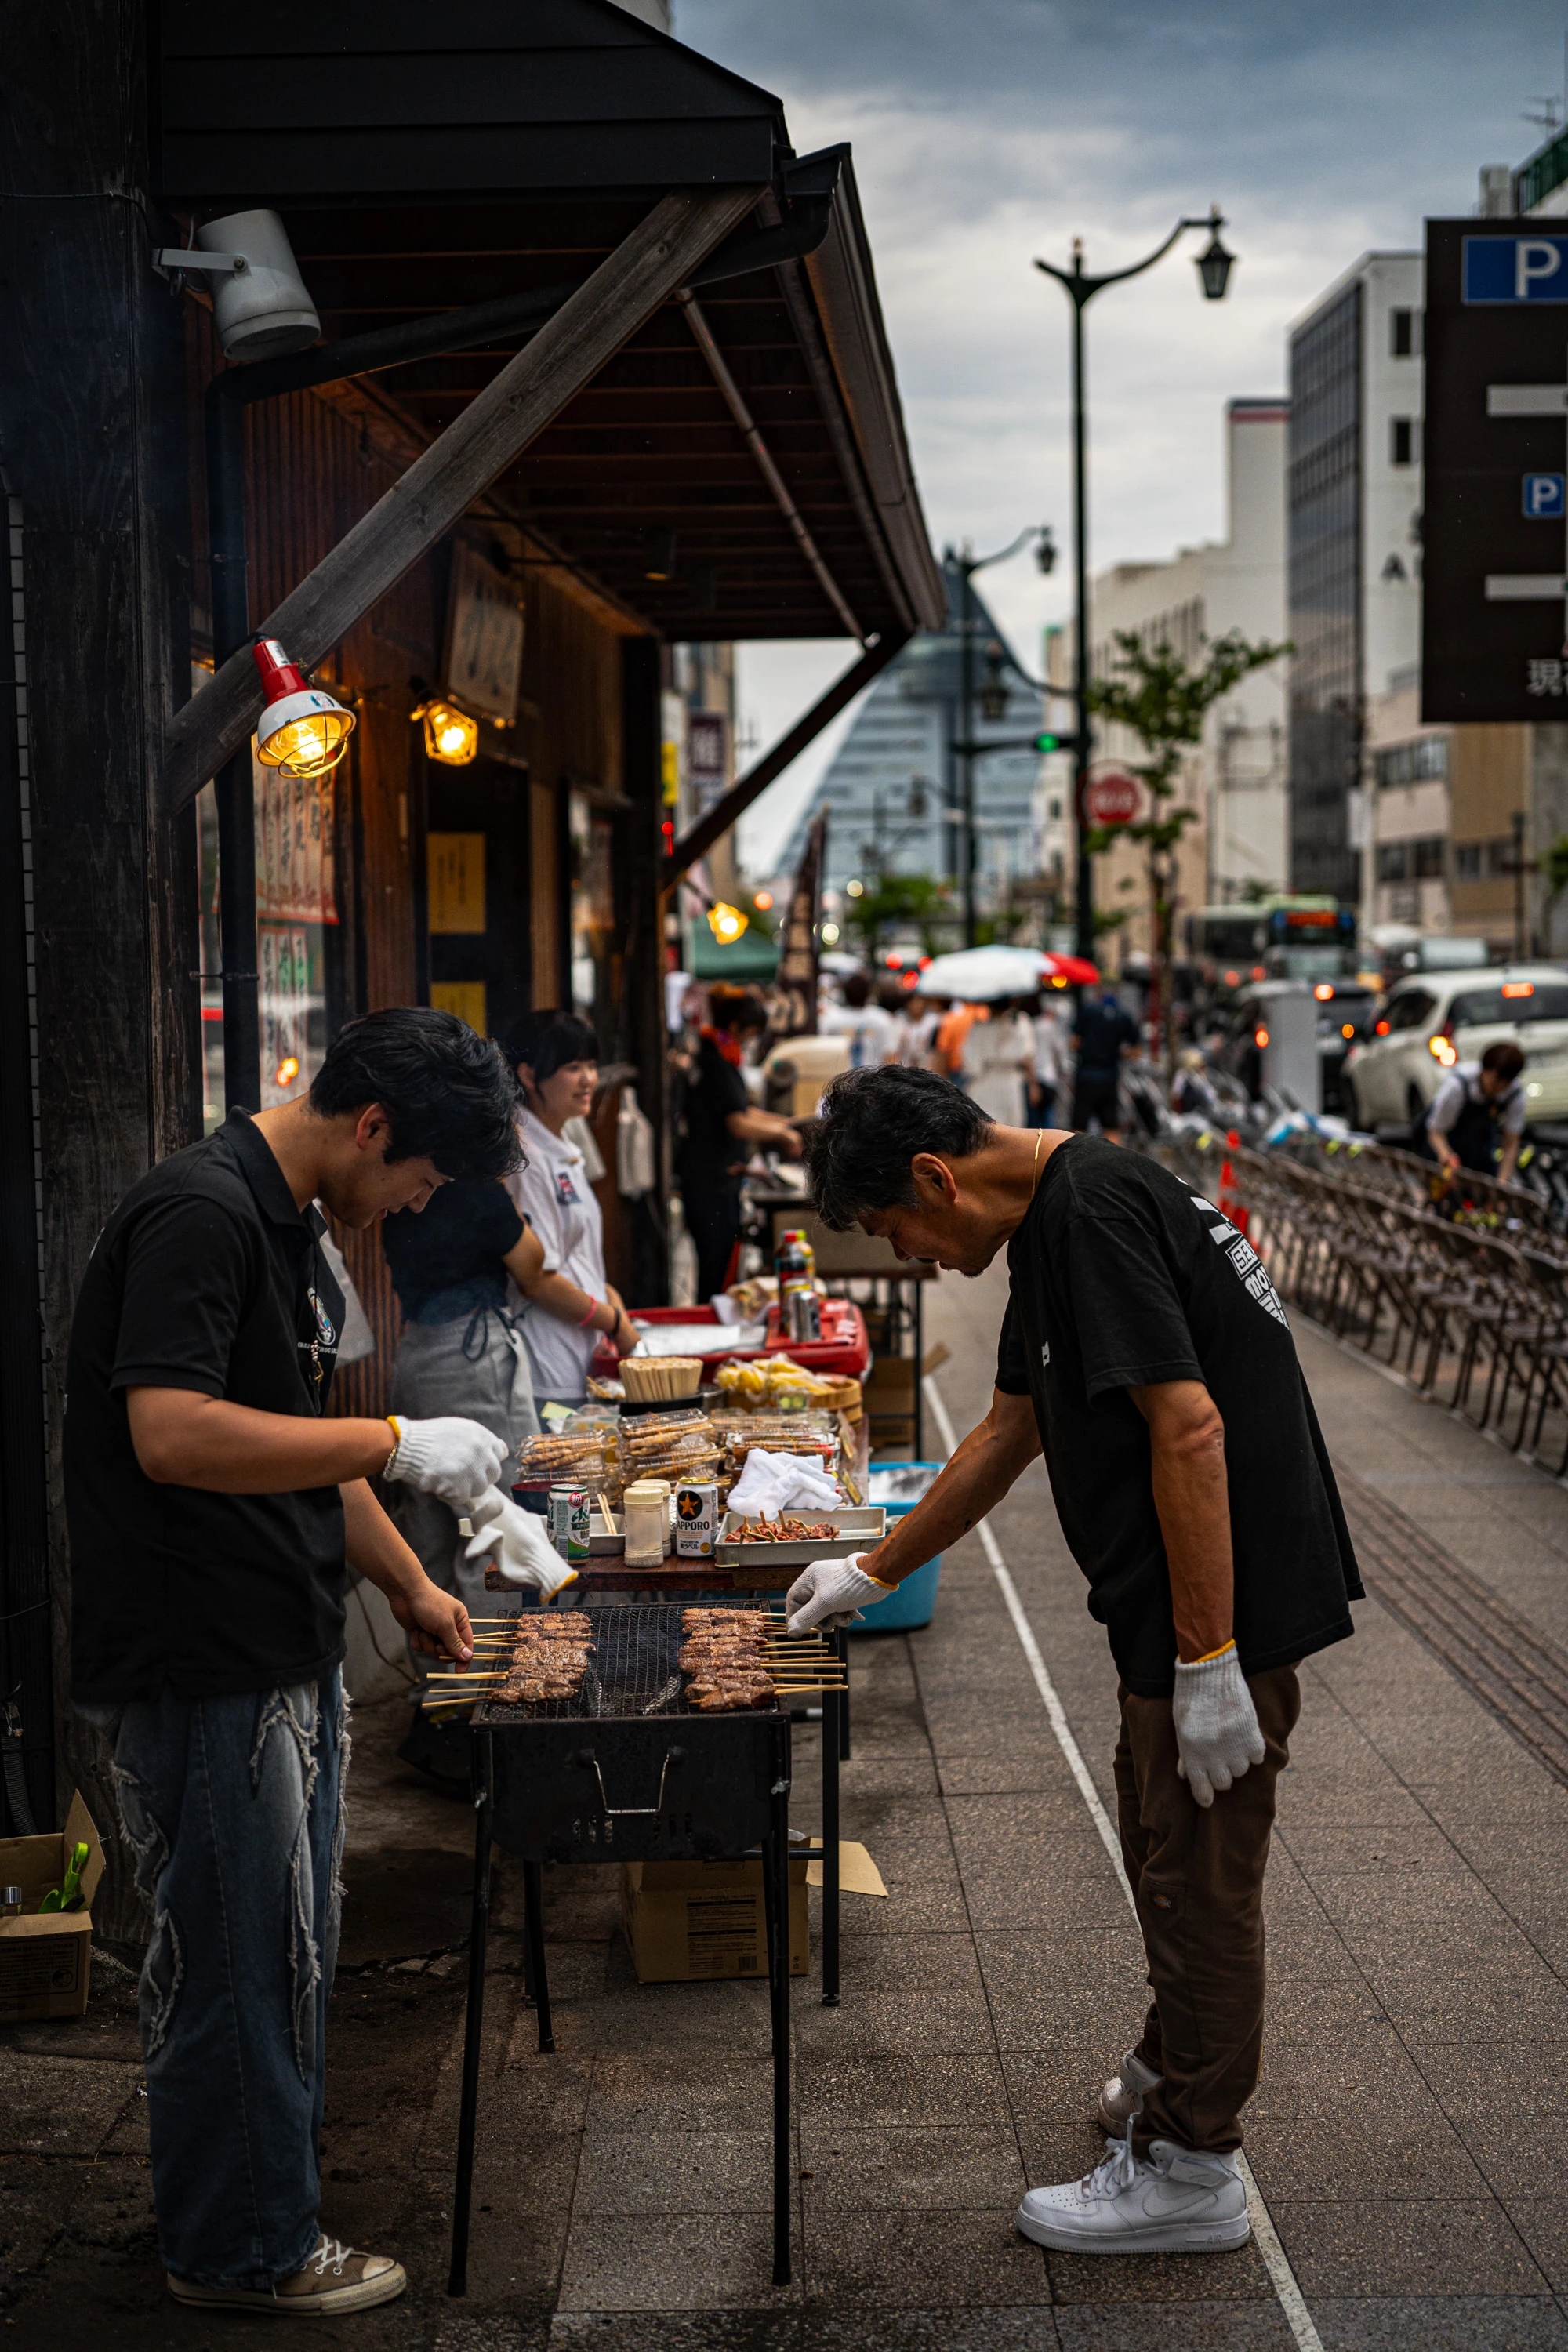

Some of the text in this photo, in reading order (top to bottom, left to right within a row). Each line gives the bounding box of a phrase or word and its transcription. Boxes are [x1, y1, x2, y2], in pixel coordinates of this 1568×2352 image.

[1515, 240, 1561, 298] P
[1532, 477, 1559, 513] P
[1526, 659, 1568, 696] 現
[572, 1506, 590, 1523] As
[677, 1521, 710, 1530] APPORO
[1208, 2234, 1223, 2244] AIR
